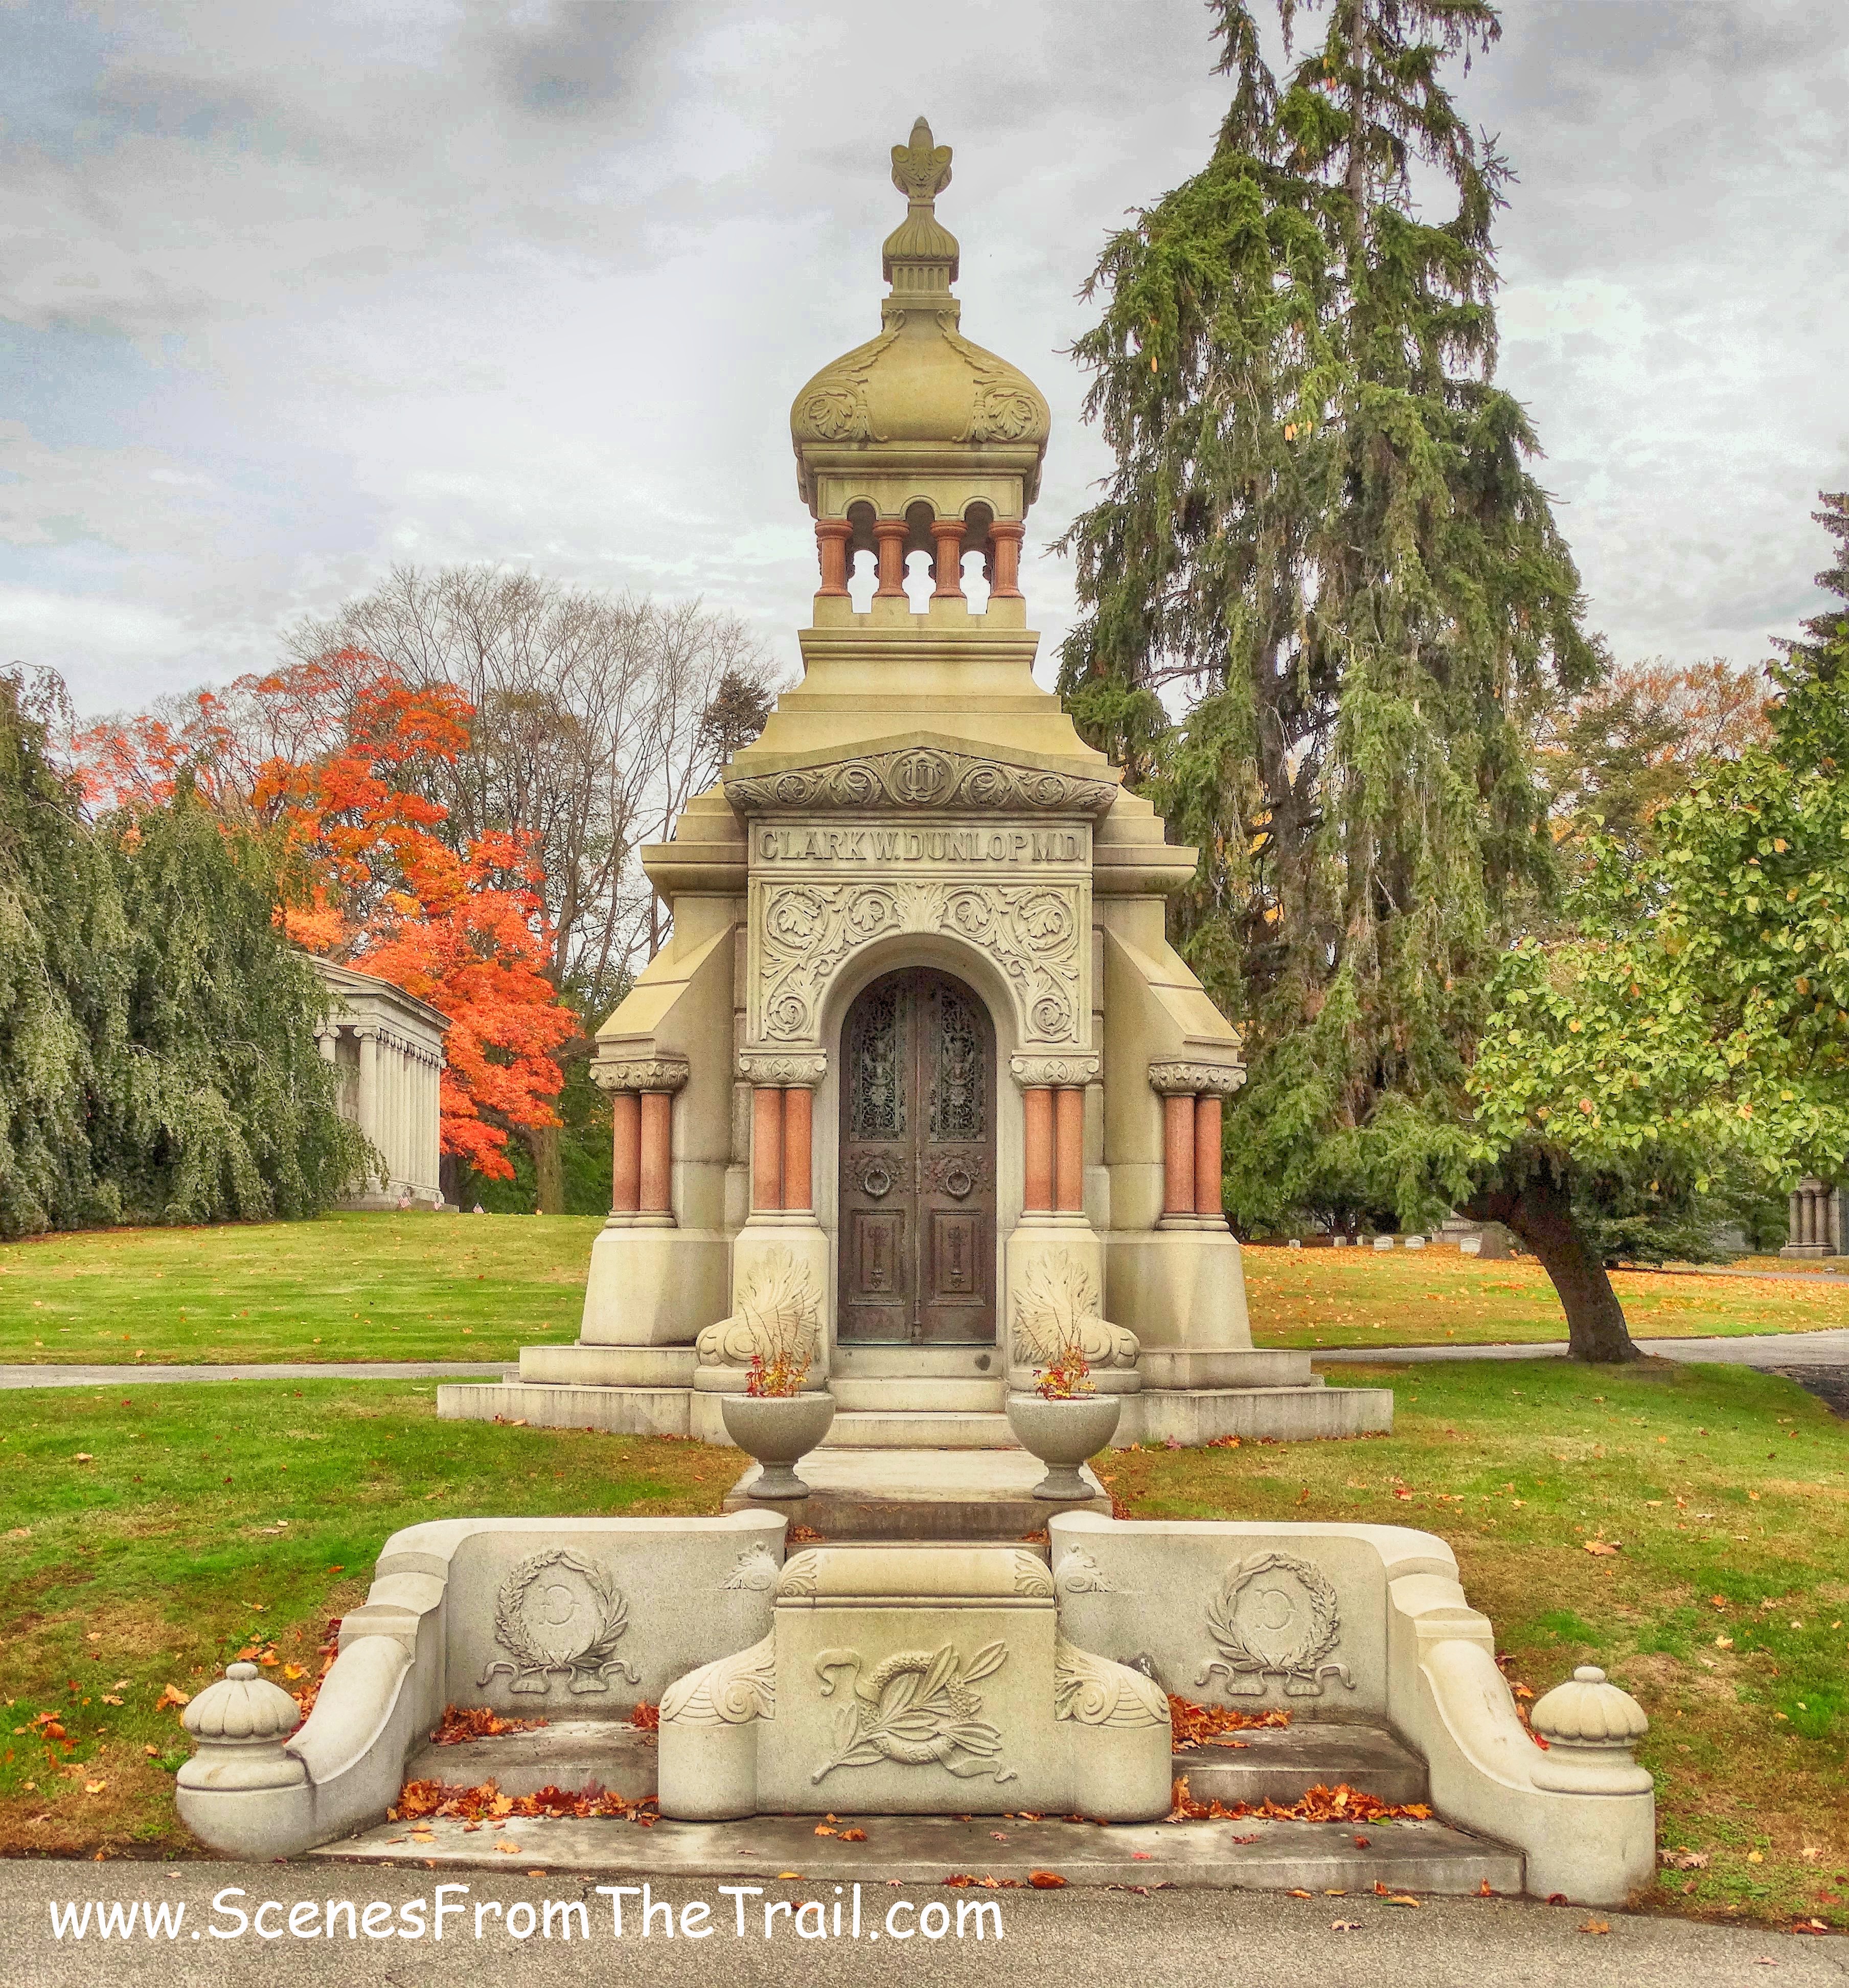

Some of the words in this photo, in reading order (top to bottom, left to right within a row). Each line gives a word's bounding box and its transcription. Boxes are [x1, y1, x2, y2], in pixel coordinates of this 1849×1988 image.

[760, 831, 866, 860] CLARK
[870, 831, 900, 860] W.
[903, 831, 1028, 861] DUNLOP
